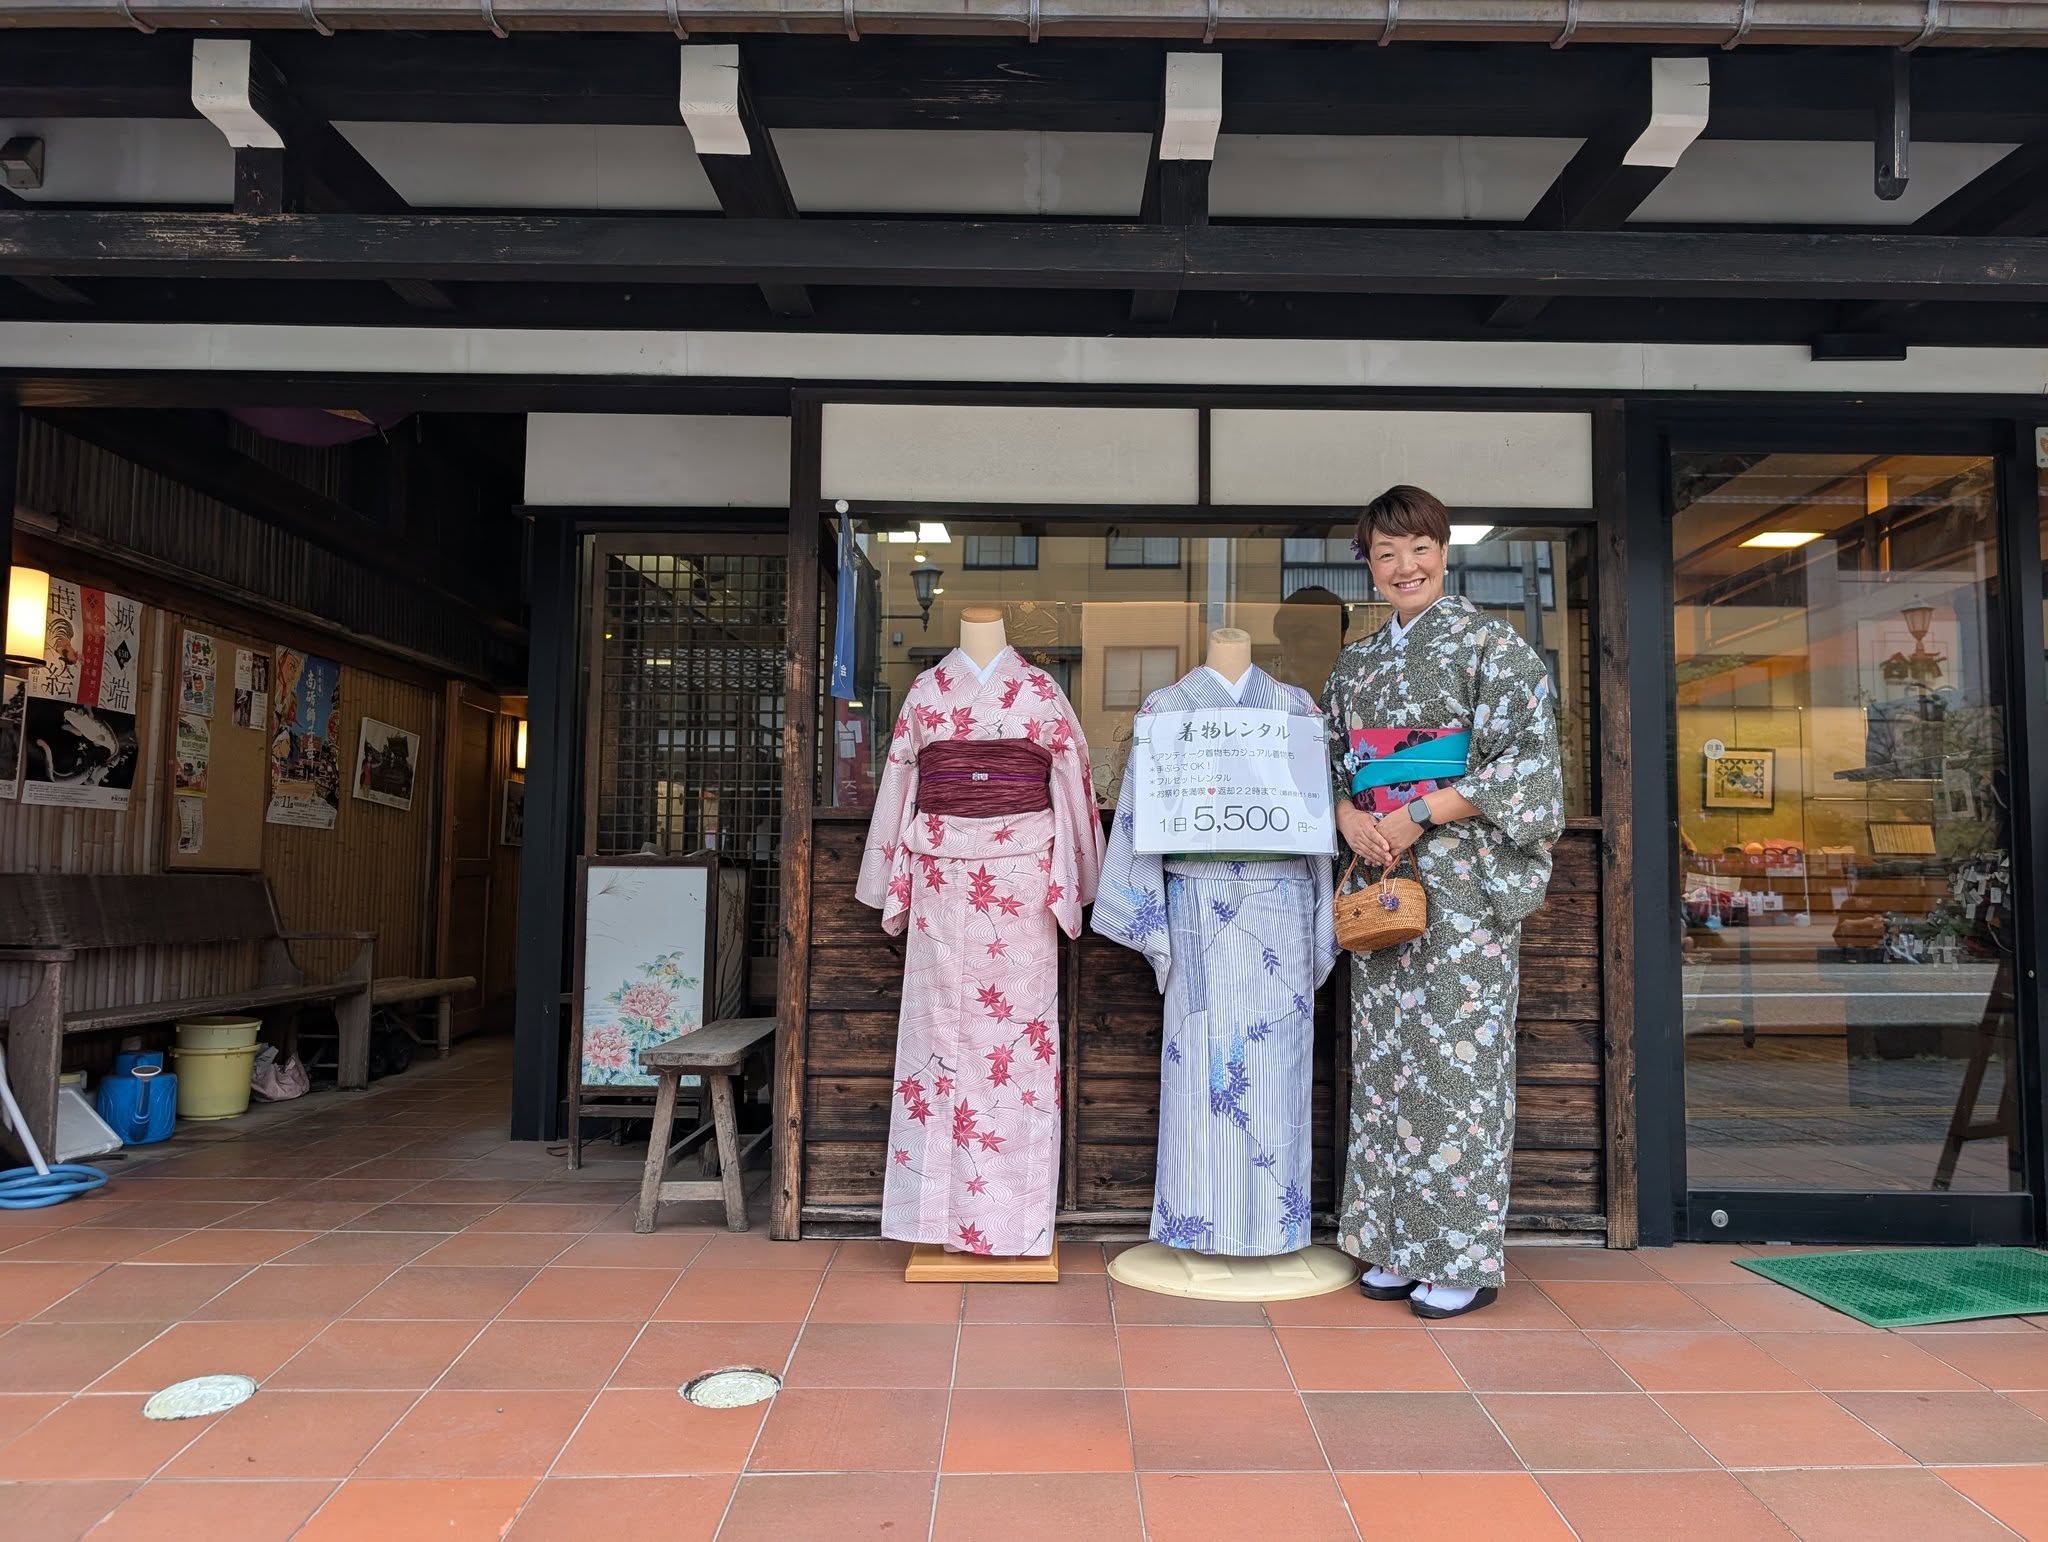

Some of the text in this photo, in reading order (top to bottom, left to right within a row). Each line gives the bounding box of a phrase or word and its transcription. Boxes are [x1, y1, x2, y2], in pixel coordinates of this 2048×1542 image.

[1177, 721, 1291, 742] 着物レンタル
[1194, 805, 1290, 833] 5,500
